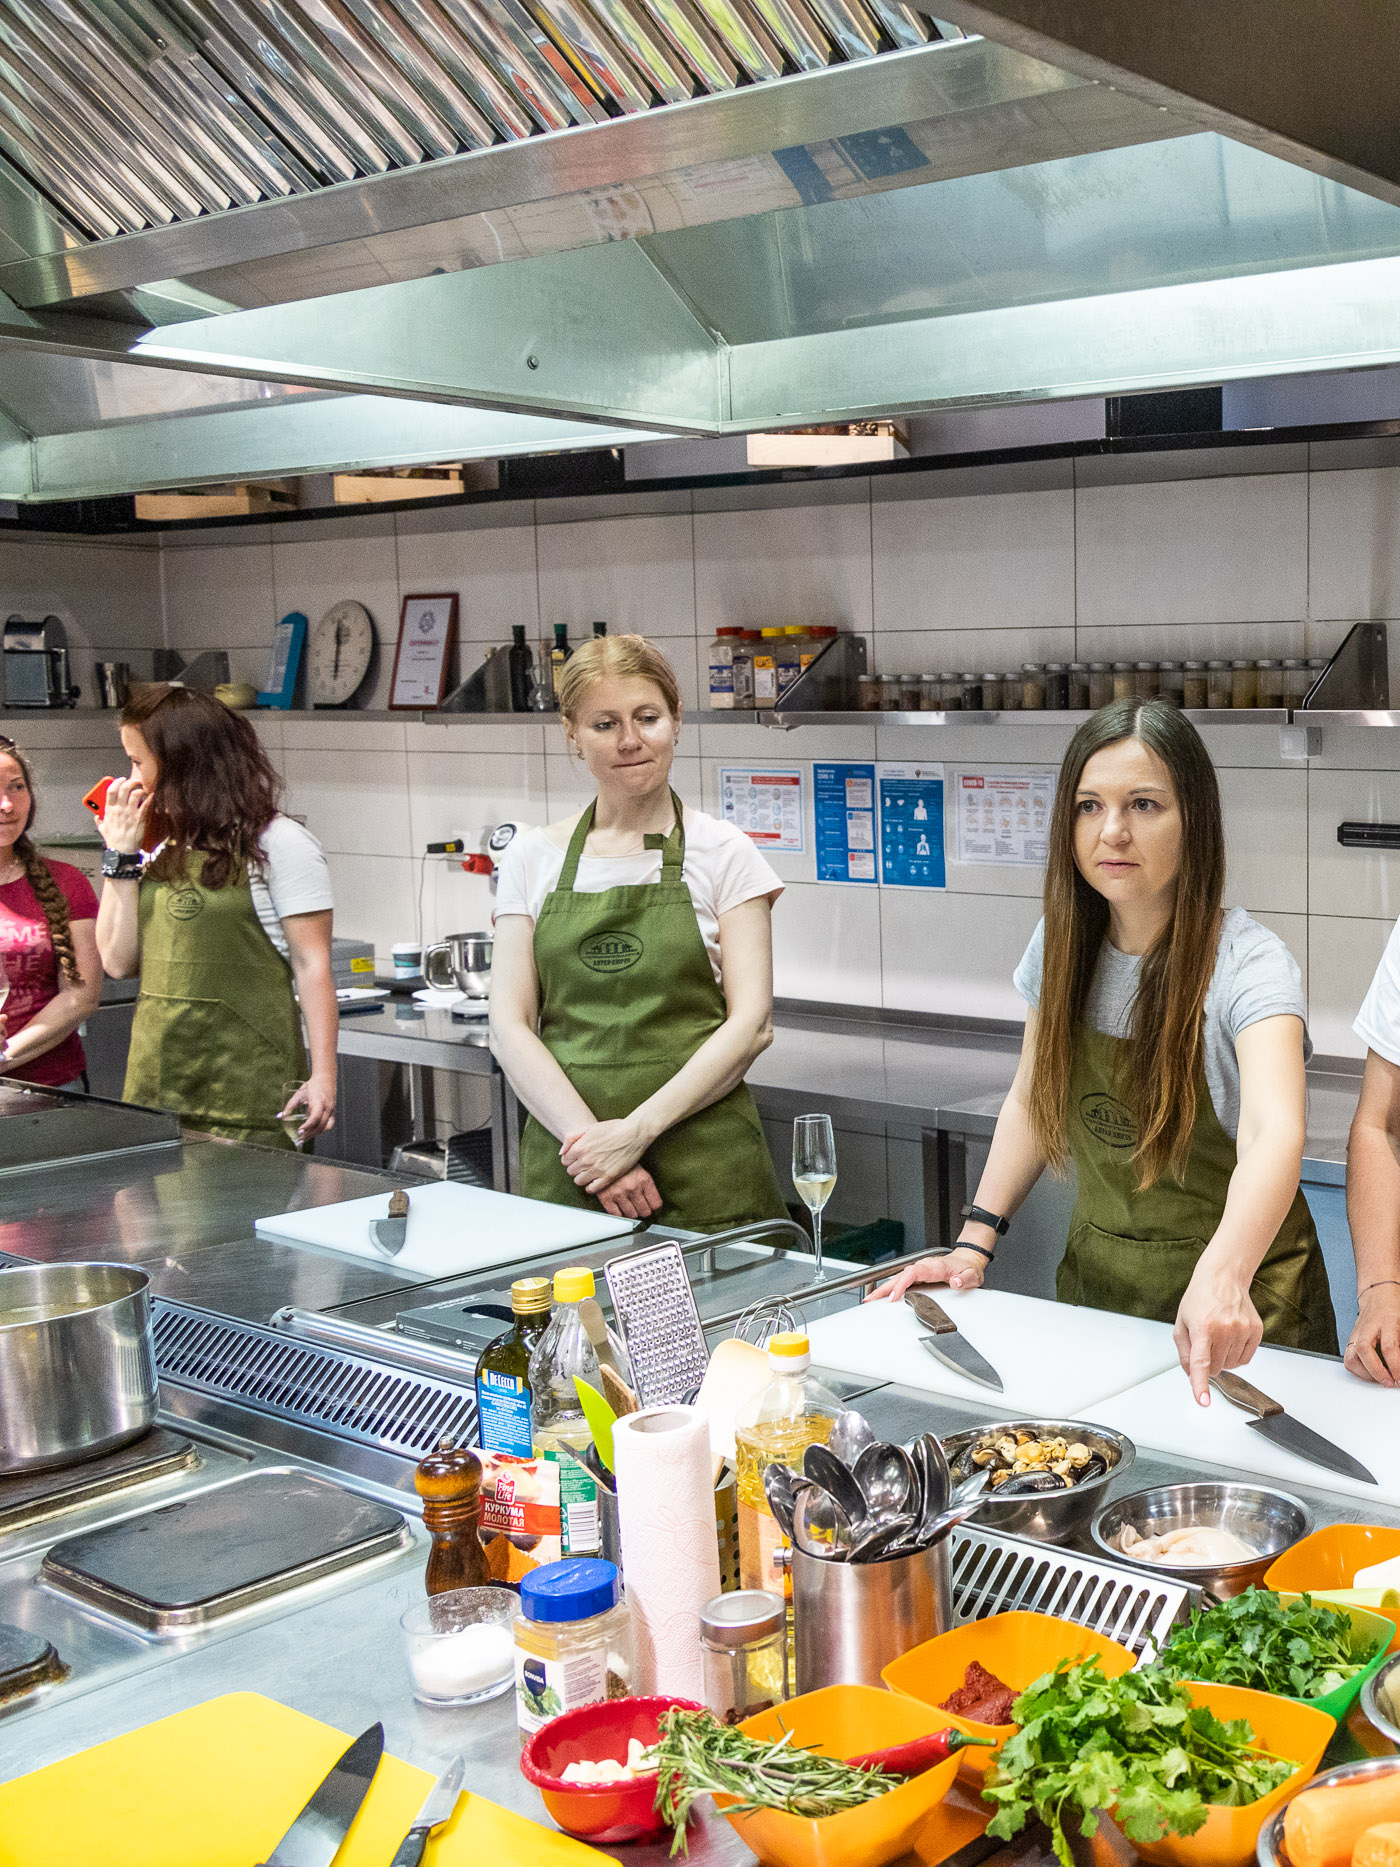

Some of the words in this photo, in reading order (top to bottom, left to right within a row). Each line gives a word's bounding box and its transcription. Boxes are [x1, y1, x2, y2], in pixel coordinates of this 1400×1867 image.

[497, 1482, 514, 1492] Fine
[497, 1491, 512, 1501] Life
[484, 1502, 525, 1518] КУРКУМА
[483, 1512, 525, 1527] МОЛОТАЯ
